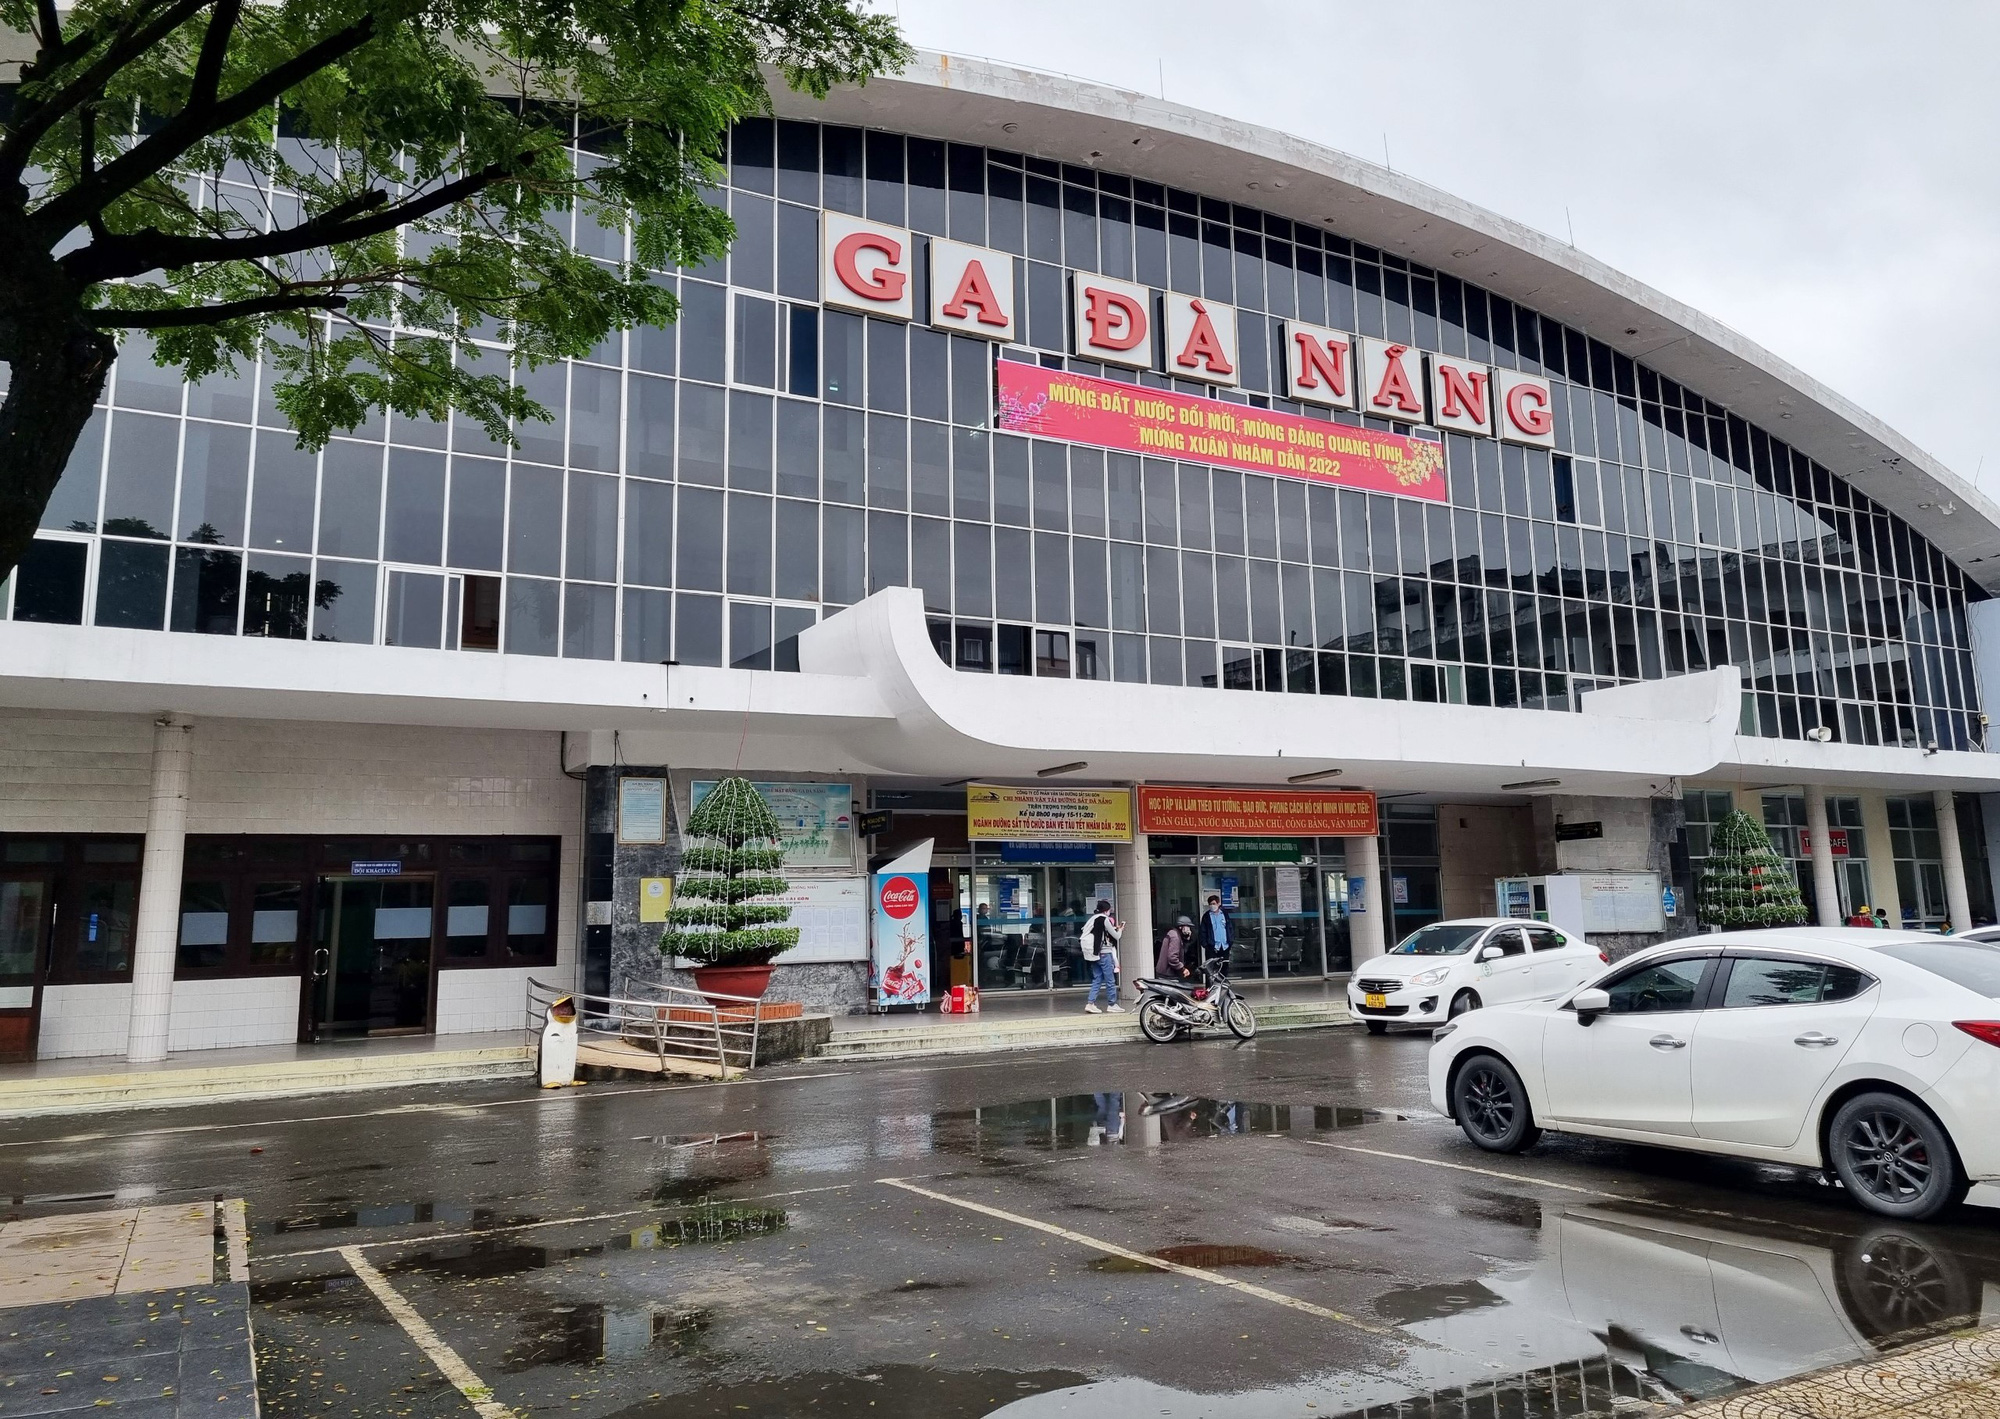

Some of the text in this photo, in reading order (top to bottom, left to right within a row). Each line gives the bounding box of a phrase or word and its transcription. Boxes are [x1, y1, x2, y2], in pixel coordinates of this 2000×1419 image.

[834, 232, 1552, 435] GA ĐÀ NẴNG
[1049, 382, 1097, 409] MỪNG
[1100, 389, 1130, 414] ĐẤT
[1134, 398, 1175, 423] NƯỚC
[1179, 404, 1204, 428] ĐỔI
[1208, 411, 1240, 436] MỚI,
[1244, 418, 1285, 442] MỪNG
[1288, 424, 1325, 449] ĐẢNG
[1328, 435, 1371, 458] QUANG
[1140, 425, 1341, 477] MỪNG XUÂN NHÂM DẦN 2022
[1149, 798, 1161, 812] HỌC
[1162, 796, 1174, 813] TẬP
[1175, 796, 1183, 811] VÀ
[1184, 796, 1197, 811] LÀM
[1198, 800, 1212, 812] THEO
[1213, 798, 1221, 812] TƯ
[1222, 797, 1242, 814] TƯỞNG,
[1243, 801, 1254, 815] ĐẠO
[1256, 799, 1269, 814] ĐỨC,
[1270, 802, 1288, 814] PHONG
[1289, 800, 1304, 814] CÁCH
[1304, 798, 1312, 814] HỒ
[1313, 800, 1322, 814] CHÍ
[1323, 802, 1338, 814] MINH
[1338, 800, 1344, 813] VÌ
[1345, 802, 1356, 816] MỤC
[973, 817, 992, 828] NGÀNH
[993, 817, 1011, 828] ĐƯỜNG
[1012, 817, 1022, 828] SẮT
[1023, 817, 1030, 828] TỔ
[1031, 818, 1045, 829] CHỨC
[1065, 819, 1075, 829] TÀU
[1076, 818, 1086, 829] TẾT
[1086, 820, 1100, 830] NHÂM
[1115, 822, 1126, 831] 2022
[1174, 814, 1196, 828] GIÀU,
[1198, 816, 1220, 827] NƯỚC
[1222, 818, 1247, 829] MẠNH,
[1248, 816, 1264, 828] DÂN
[1266, 816, 1284, 829] CHỦ,
[1286, 817, 1306, 828] CÔNG
[1308, 816, 1330, 829] BẰNG,
[1331, 818, 1346, 828] VĂN
[1830, 838, 1846, 848] CAFE
